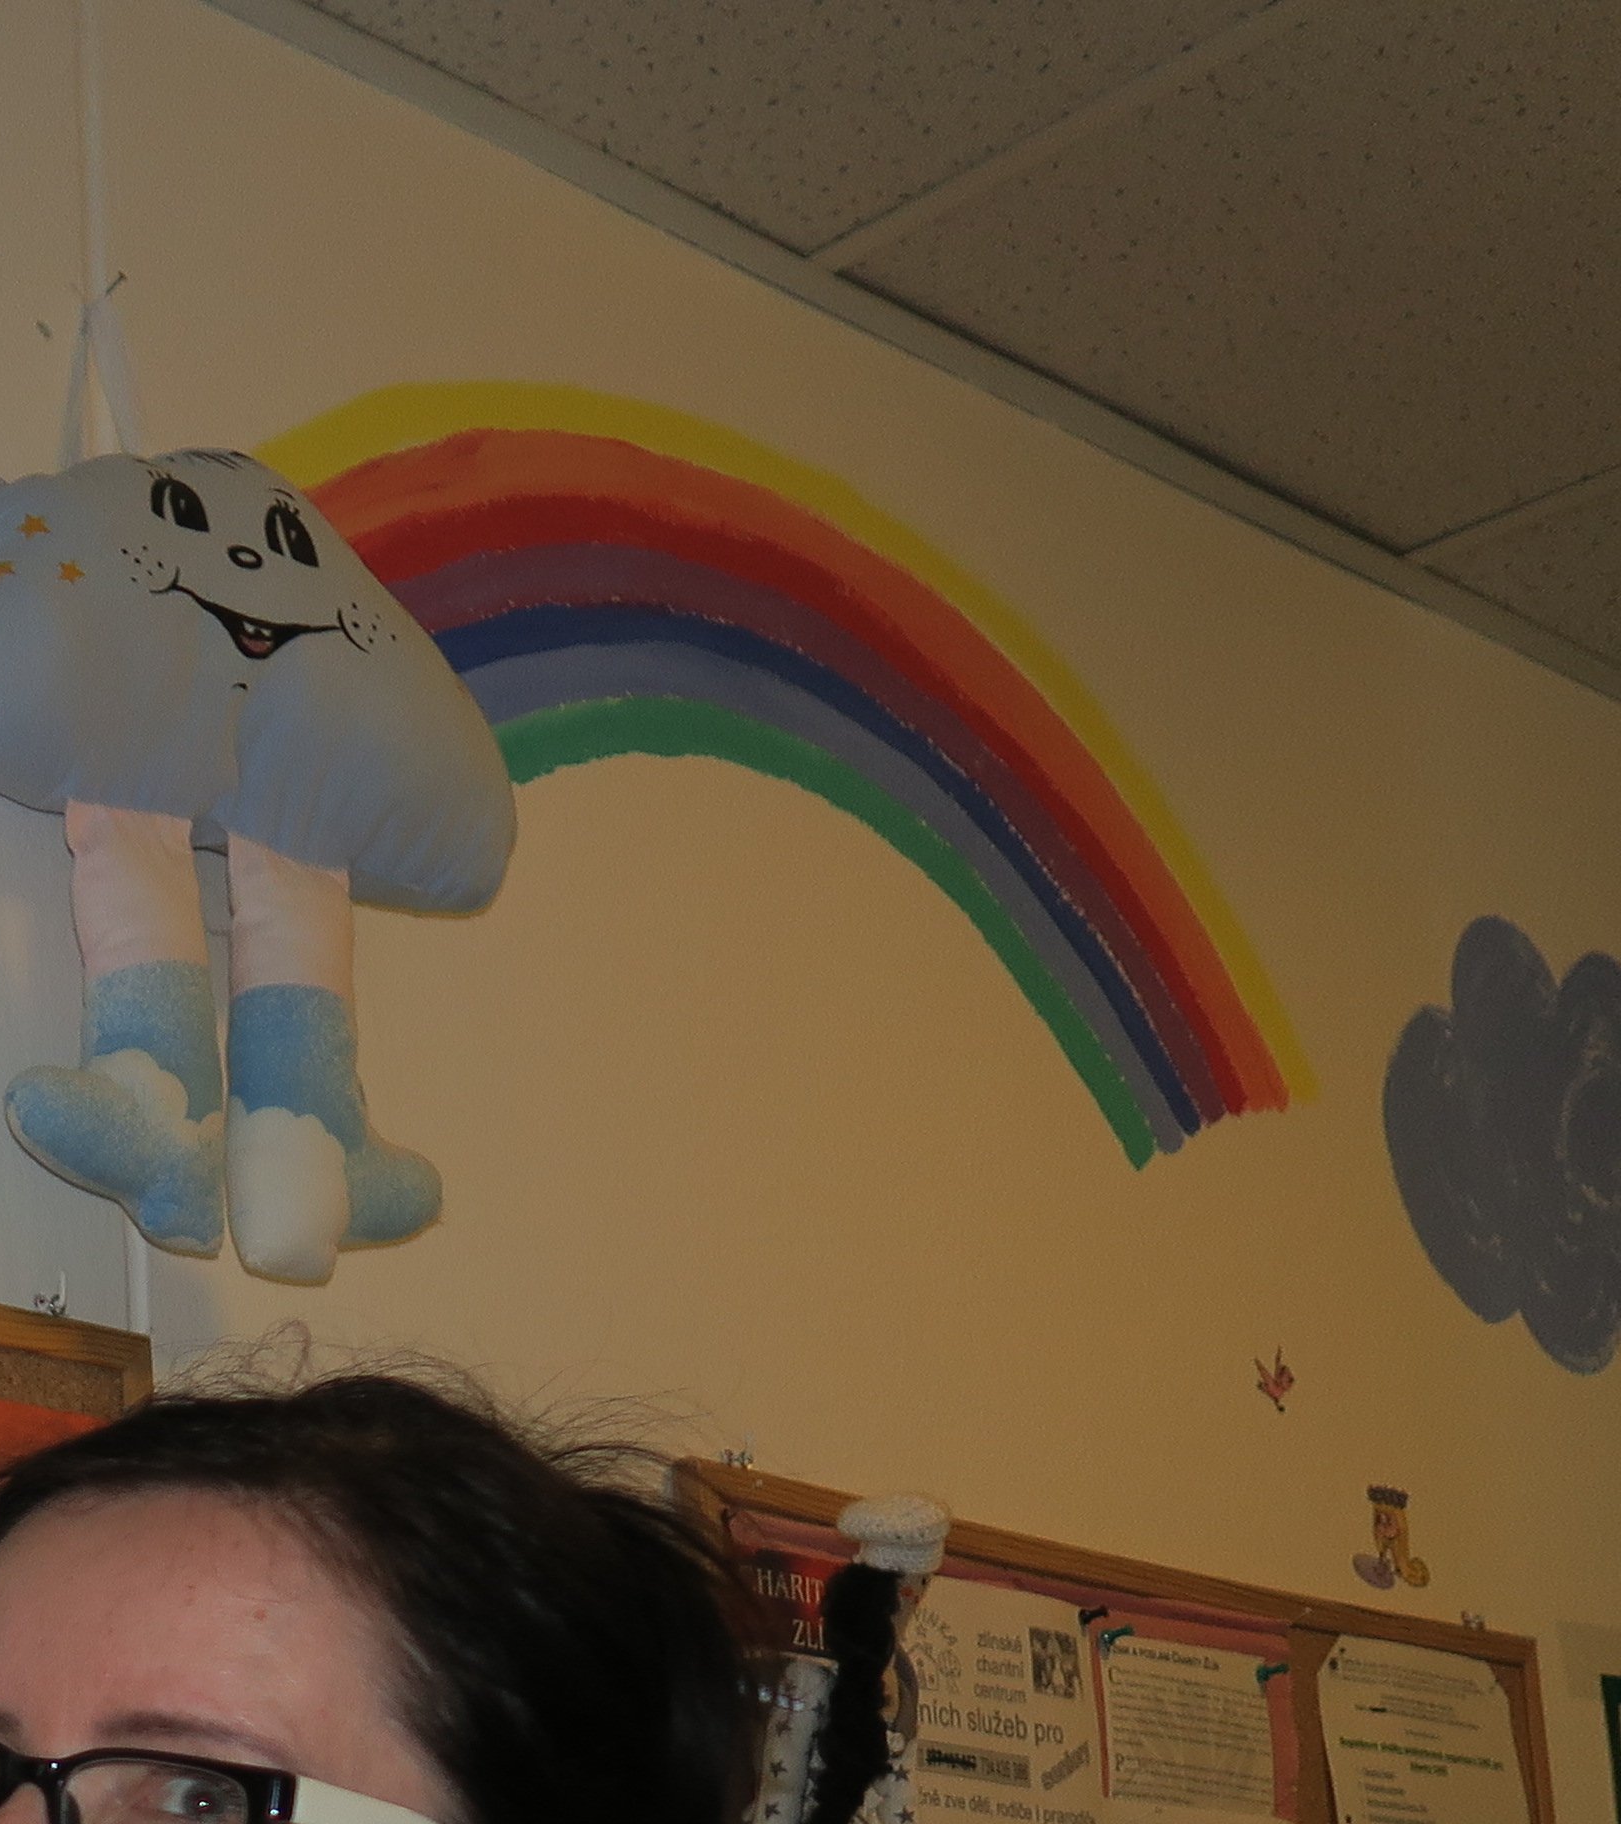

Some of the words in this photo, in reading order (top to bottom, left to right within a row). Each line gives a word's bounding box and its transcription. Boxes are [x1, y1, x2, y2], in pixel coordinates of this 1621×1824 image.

[756, 1567, 825, 1605] HARIT
[791, 1618, 825, 1651] ZLÍ
[966, 1707, 1028, 1741] služeb
[1033, 1722, 1065, 1747] pro
